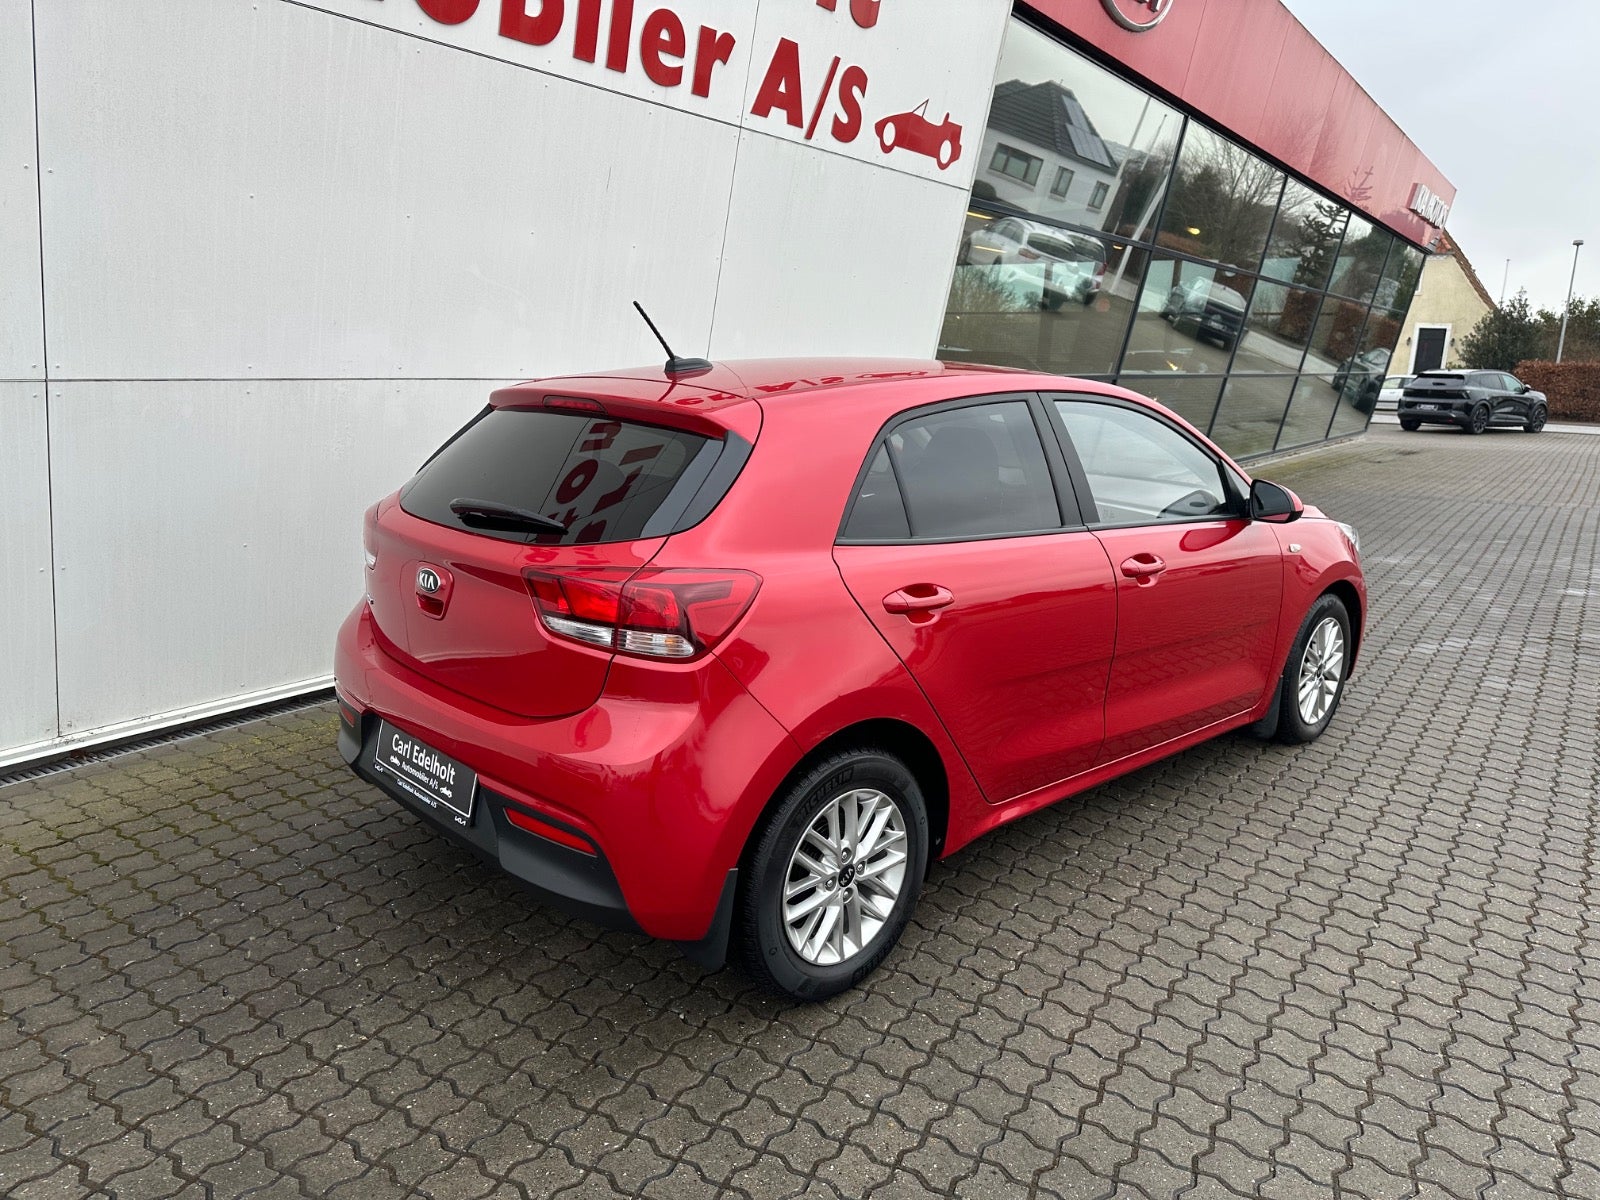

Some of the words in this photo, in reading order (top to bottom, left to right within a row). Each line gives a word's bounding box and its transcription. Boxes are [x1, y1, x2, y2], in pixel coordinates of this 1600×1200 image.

[750, 37, 868, 143] A/S
[419, 572, 435, 590] KIA
[392, 734, 411, 758] Carl
[412, 745, 455, 785] Edelholt
[840, 868, 854, 886] KIA
